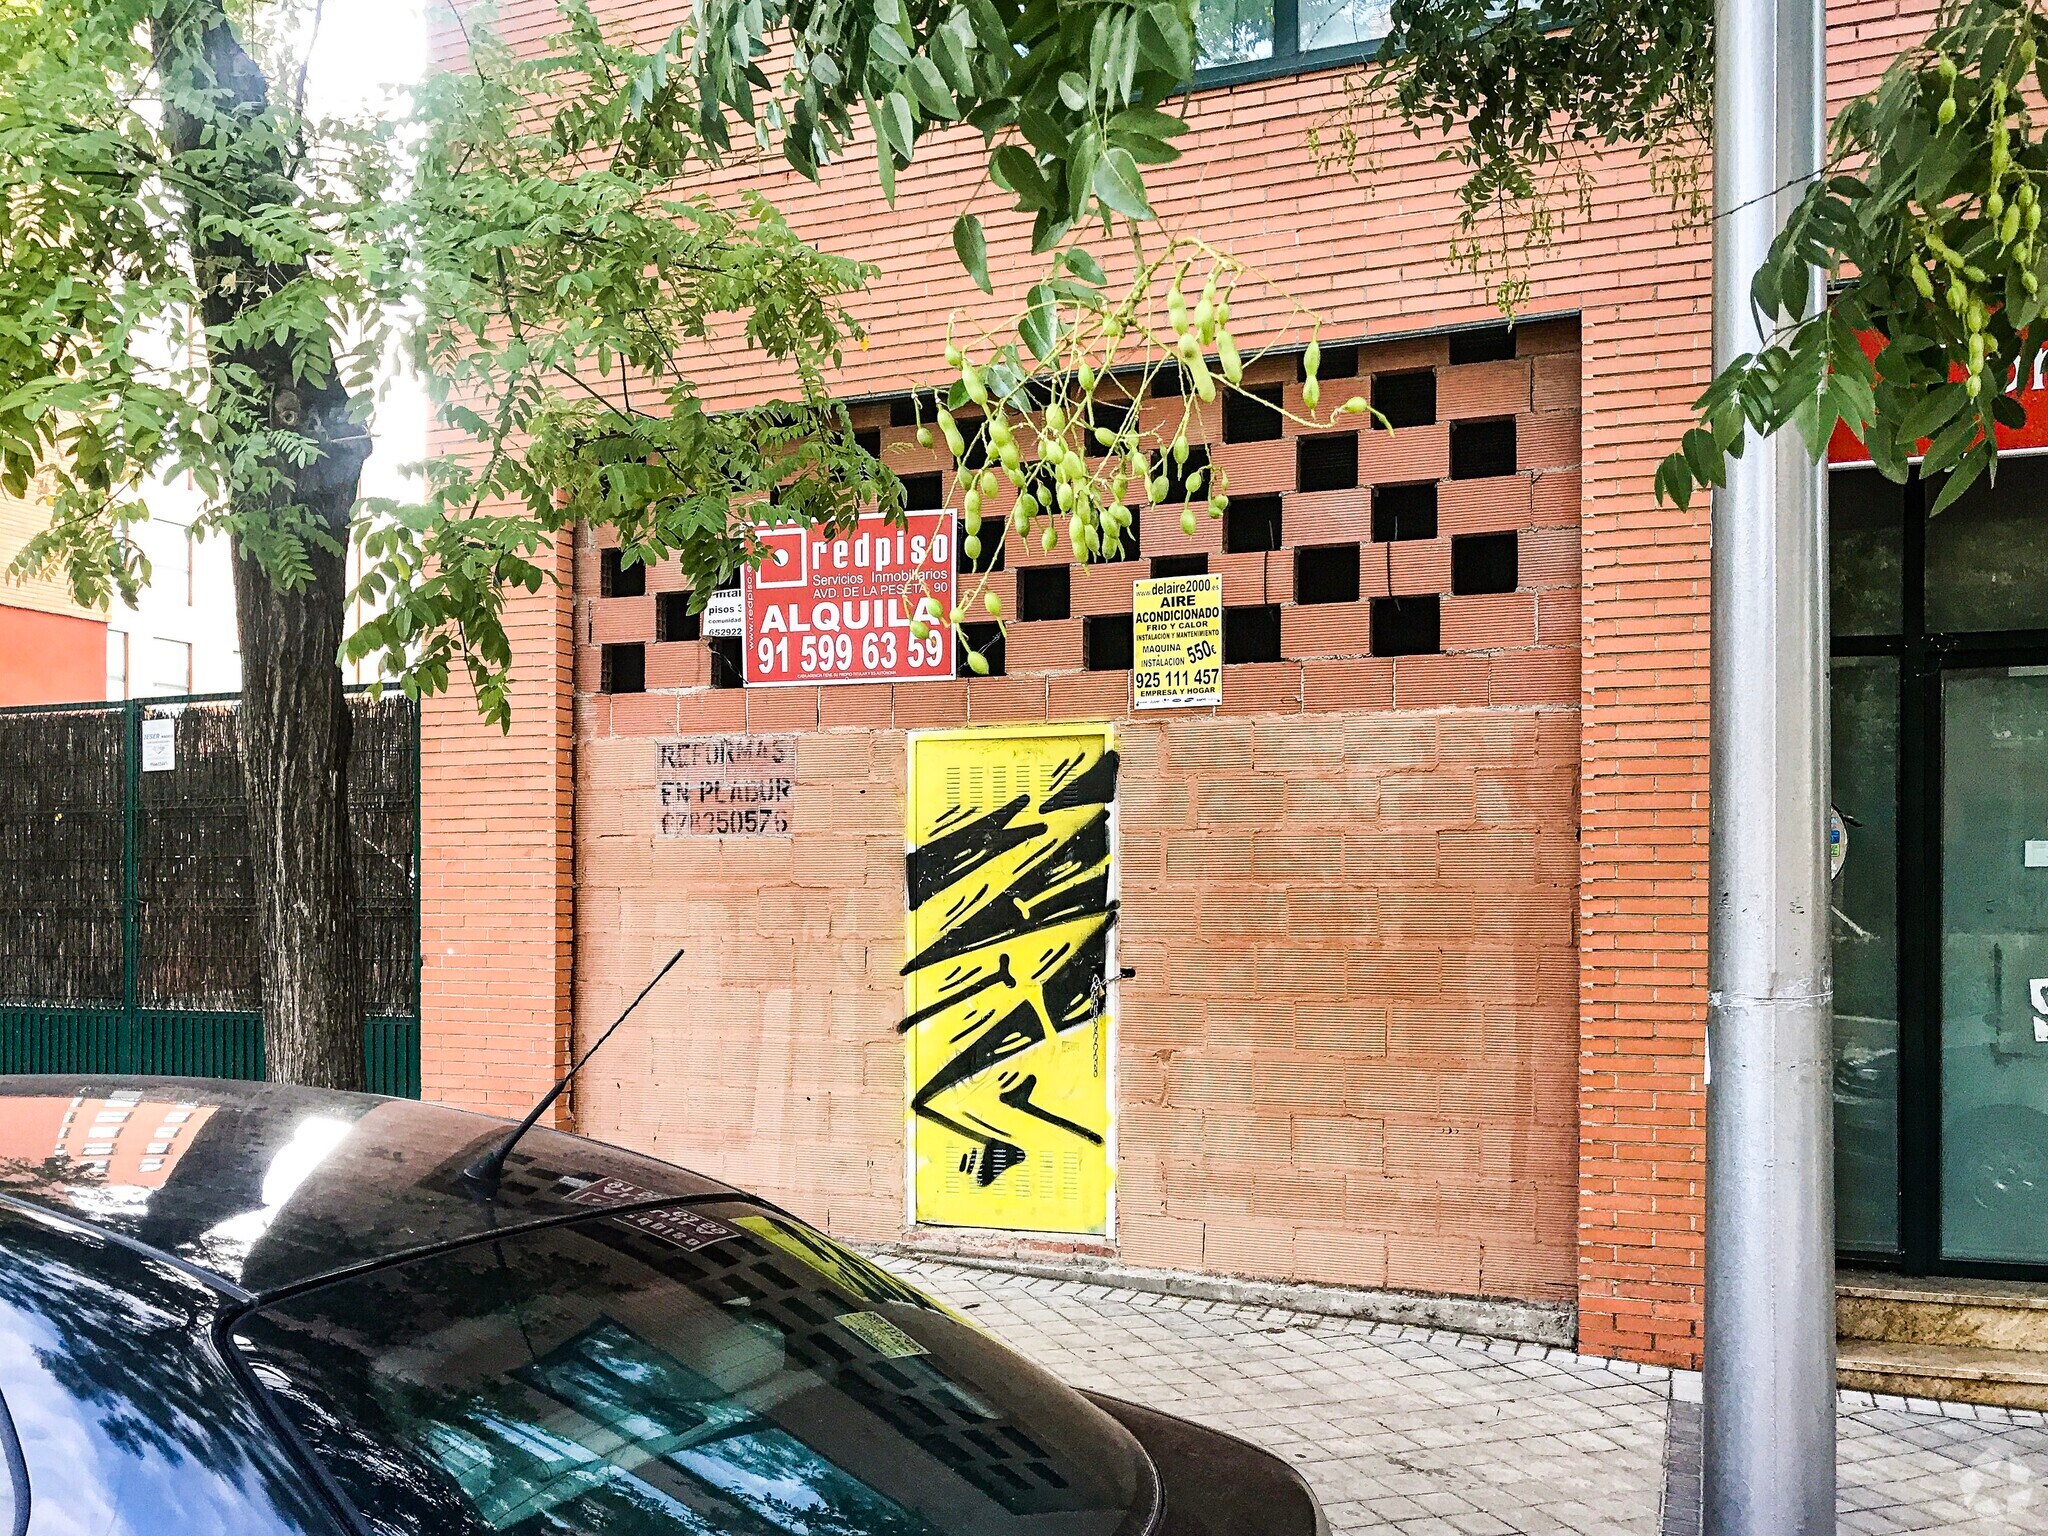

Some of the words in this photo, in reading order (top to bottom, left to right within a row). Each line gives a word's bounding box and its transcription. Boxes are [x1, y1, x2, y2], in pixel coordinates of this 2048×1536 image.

[812, 531, 949, 572] redpiso
[812, 574, 864, 587] Servicios
[813, 588, 840, 599] AVD.
[843, 587, 860, 597] DE
[863, 586, 878, 597] LA
[880, 583, 928, 596] PESETA
[933, 582, 948, 593] 90
[746, 557, 755, 650] www.redpiso.e
[1160, 595, 1196, 608] AIRE
[709, 605, 735, 616] pisos
[759, 597, 941, 634] ALQUILA
[1136, 607, 1219, 623] ACONDICIONADO
[1179, 621, 1208, 629] CALOR
[1176, 629, 1219, 638] MANTENIMIENTO
[757, 636, 789, 674] 91
[800, 633, 853, 672] 599
[861, 631, 898, 670] 63
[907, 629, 944, 668] 59
[1136, 672, 1160, 688] 925
[1165, 670, 1188, 686] 111
[1194, 668, 1219, 685] 457
[1140, 689, 1177, 697] EMPRESA
[661, 781, 690, 806] EN
